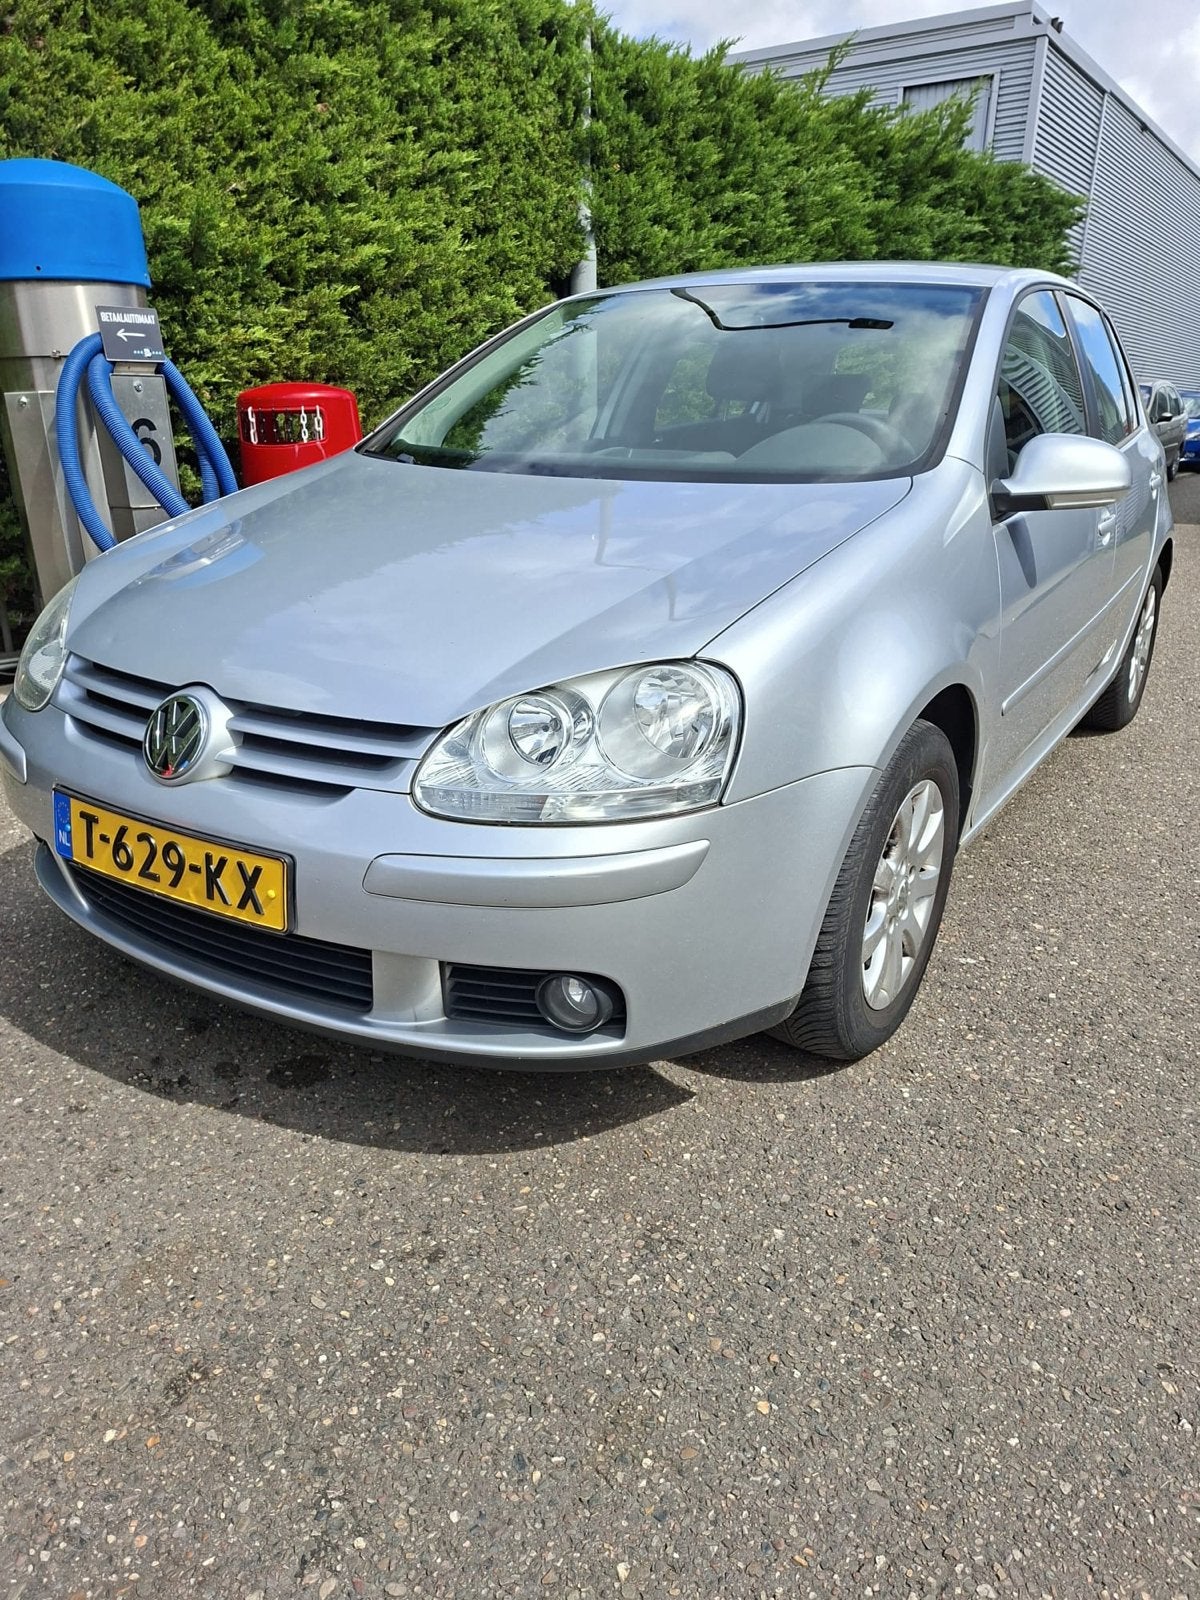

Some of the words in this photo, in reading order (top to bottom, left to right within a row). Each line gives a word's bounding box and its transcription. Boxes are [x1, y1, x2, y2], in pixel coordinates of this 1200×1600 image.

[100, 311, 155, 325] BETAALAUTOMAAT
[131, 417, 162, 466] 6
[58, 829, 71, 847] NL
[79, 810, 265, 916] T-629-KX
